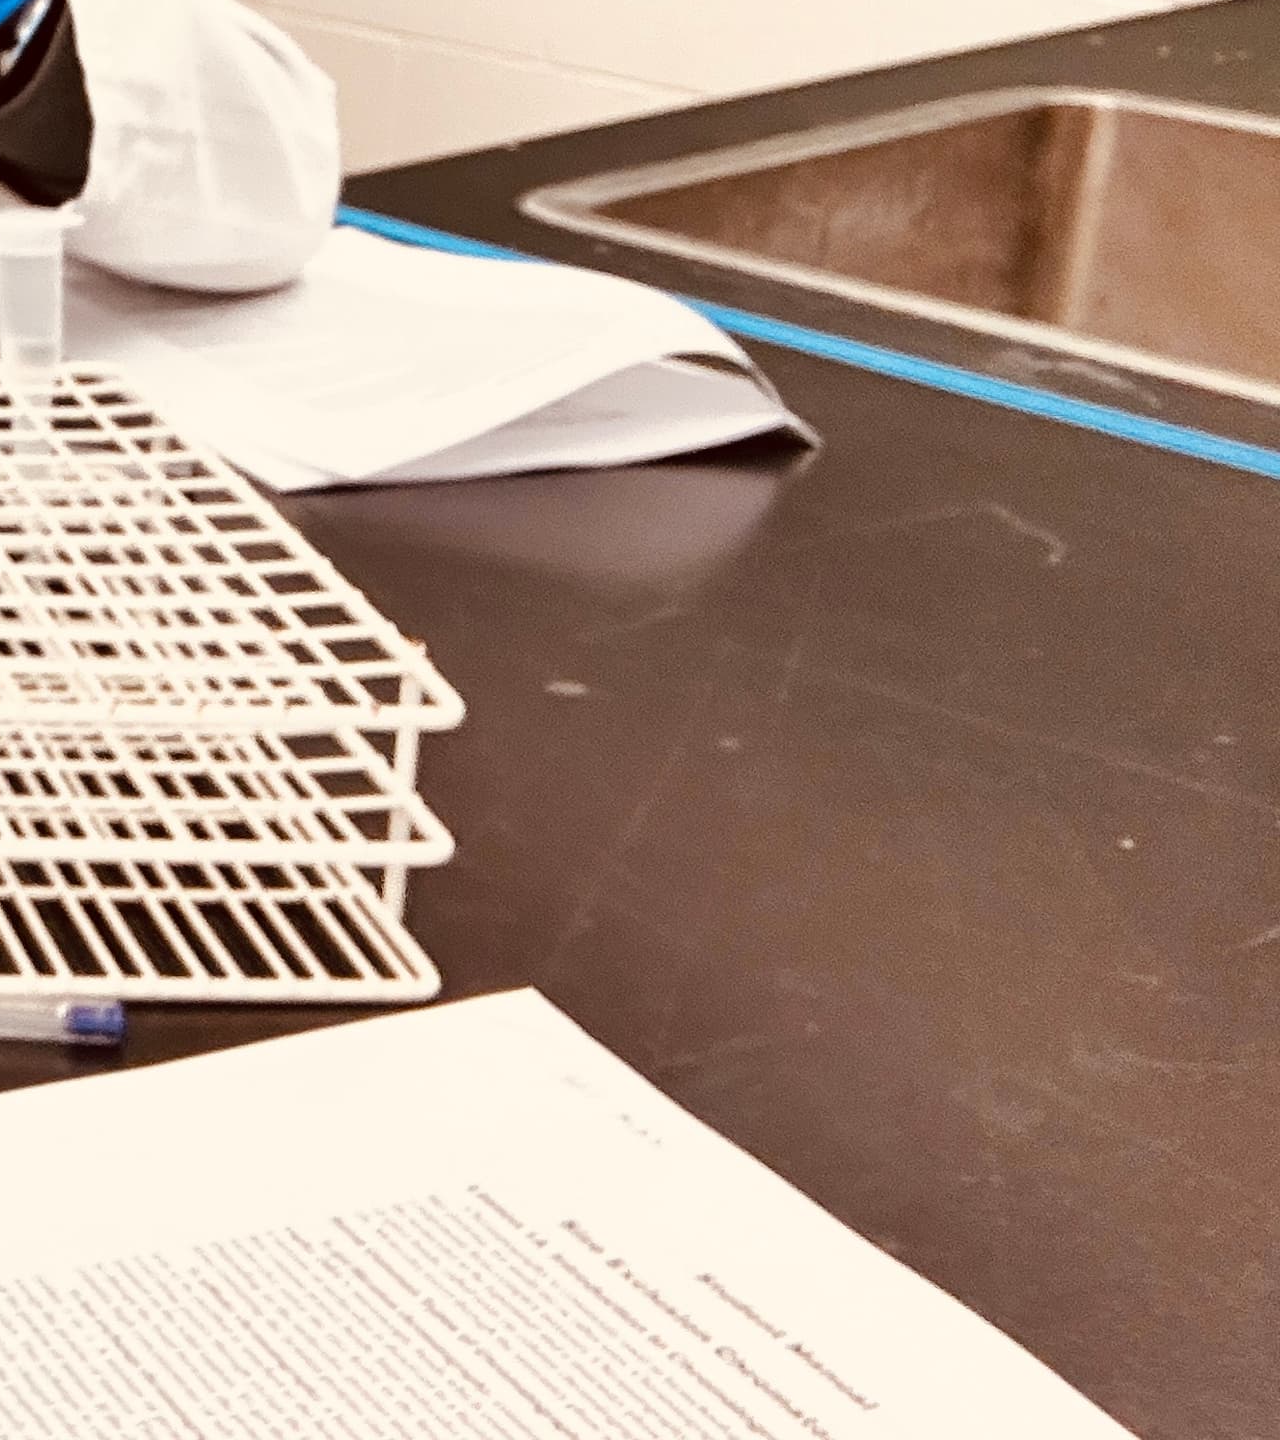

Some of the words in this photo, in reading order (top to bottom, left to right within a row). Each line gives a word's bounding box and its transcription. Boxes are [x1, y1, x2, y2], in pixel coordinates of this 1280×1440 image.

[605, 1258, 711, 1343] Exclusion
[696, 1273, 787, 1339] Student
[786, 1342, 881, 1411] Manual
